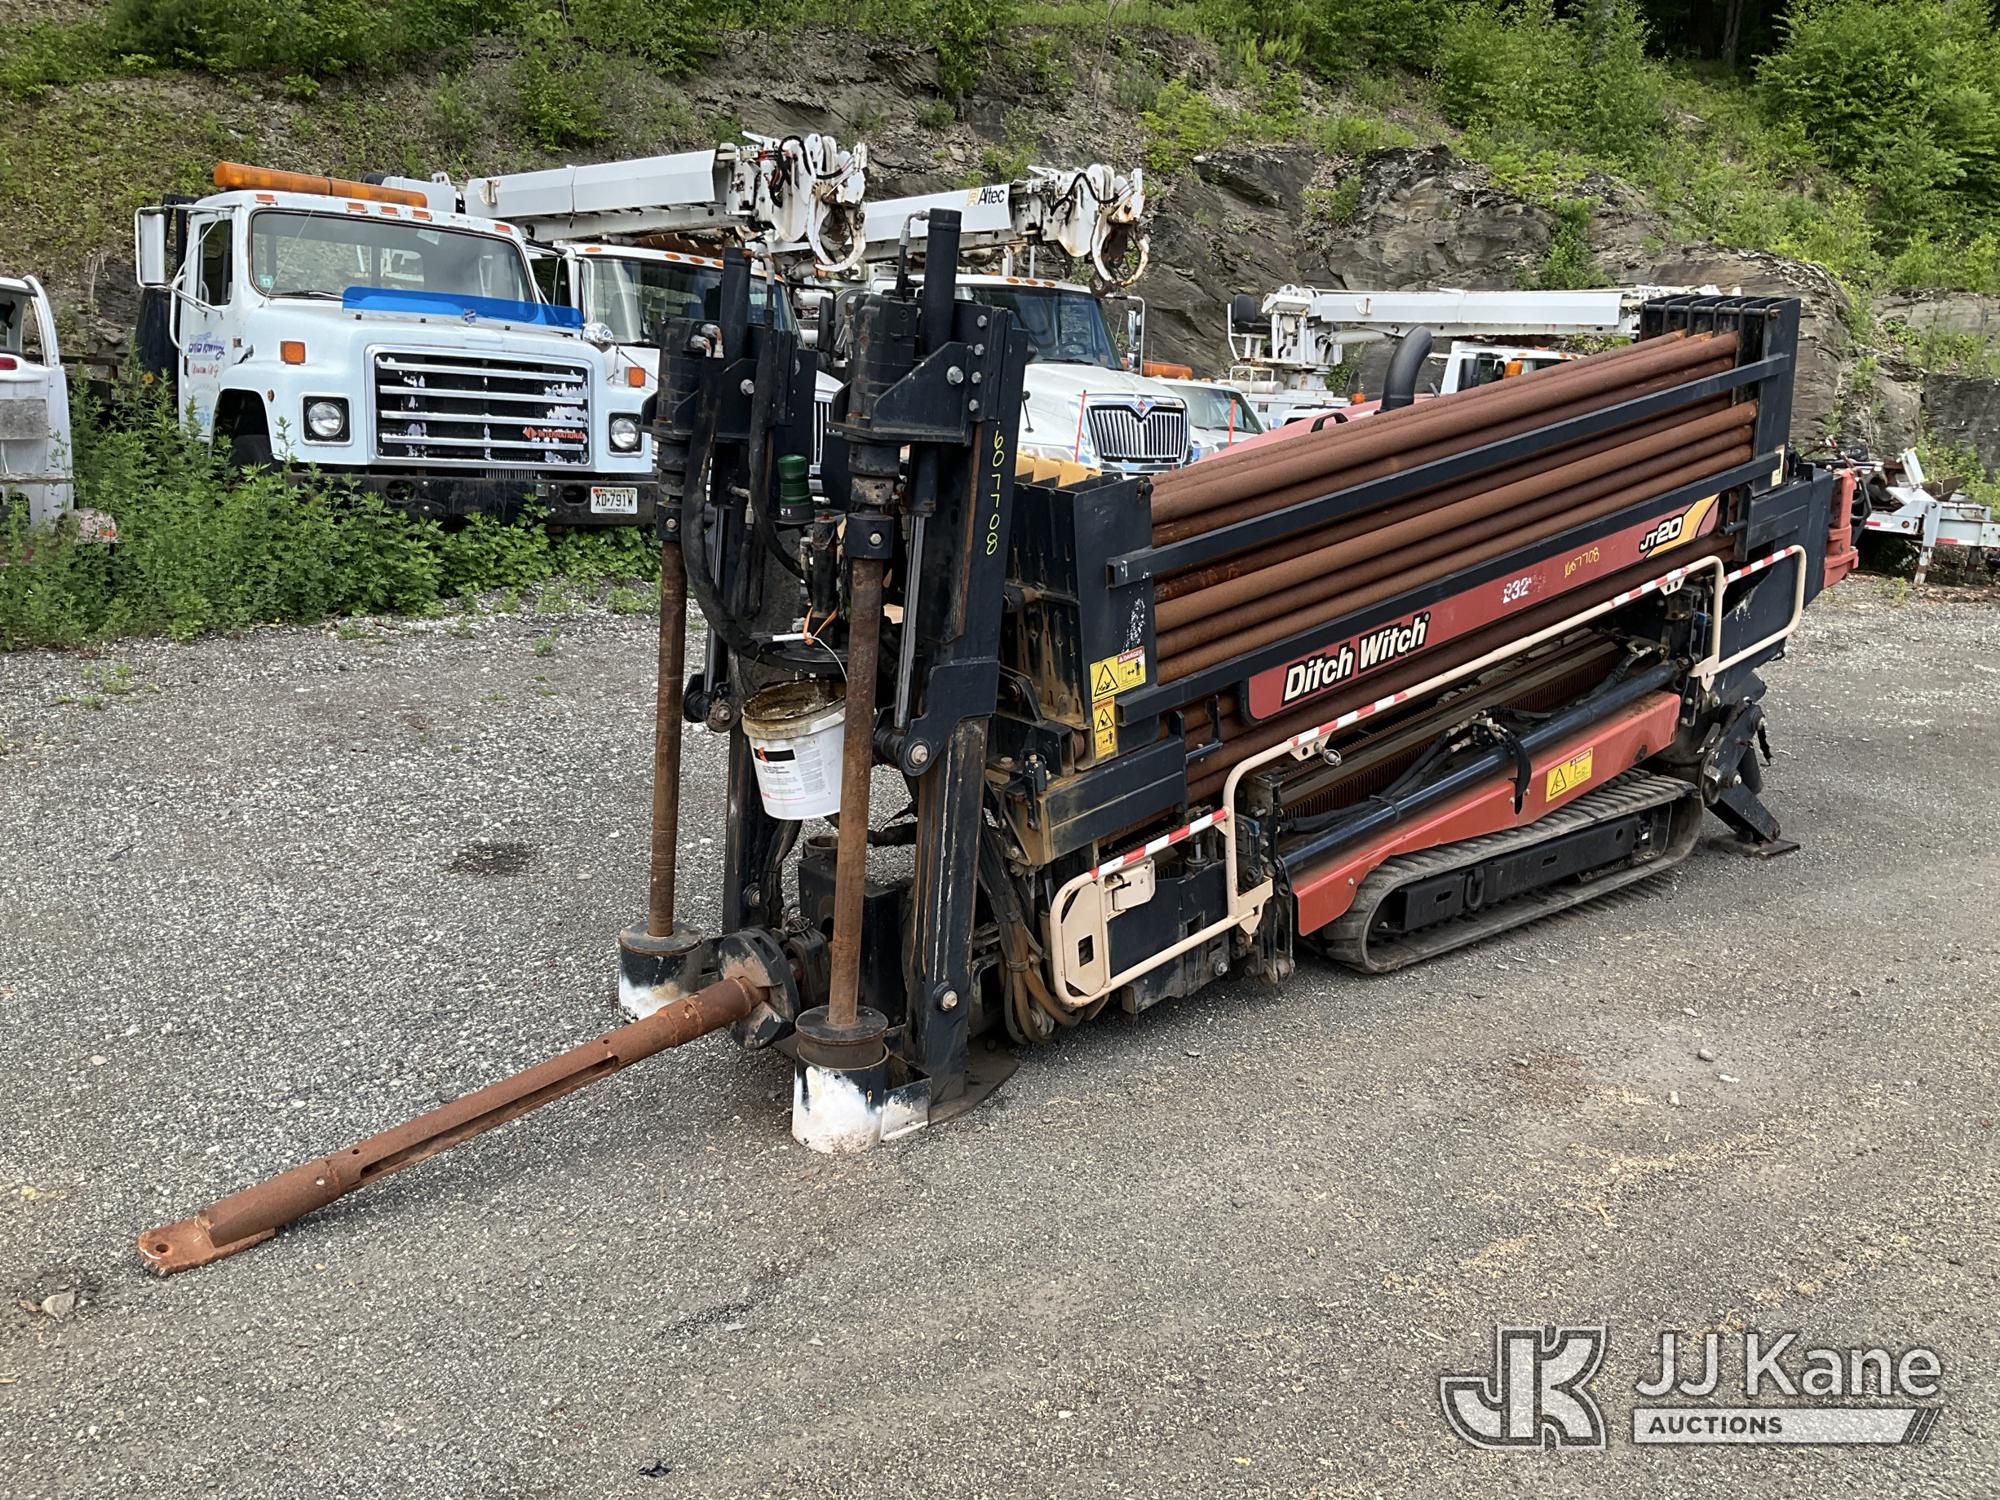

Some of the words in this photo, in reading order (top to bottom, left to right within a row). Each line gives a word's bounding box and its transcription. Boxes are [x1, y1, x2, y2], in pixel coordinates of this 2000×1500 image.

[978, 187, 1005, 205] Altec
[538, 431, 584, 440] INTERNATIONAL
[986, 430, 1005, 555] 607708
[1640, 516, 1683, 550] JT20
[1284, 646, 1354, 701] Ditch
[1360, 615, 1428, 669] Witch
